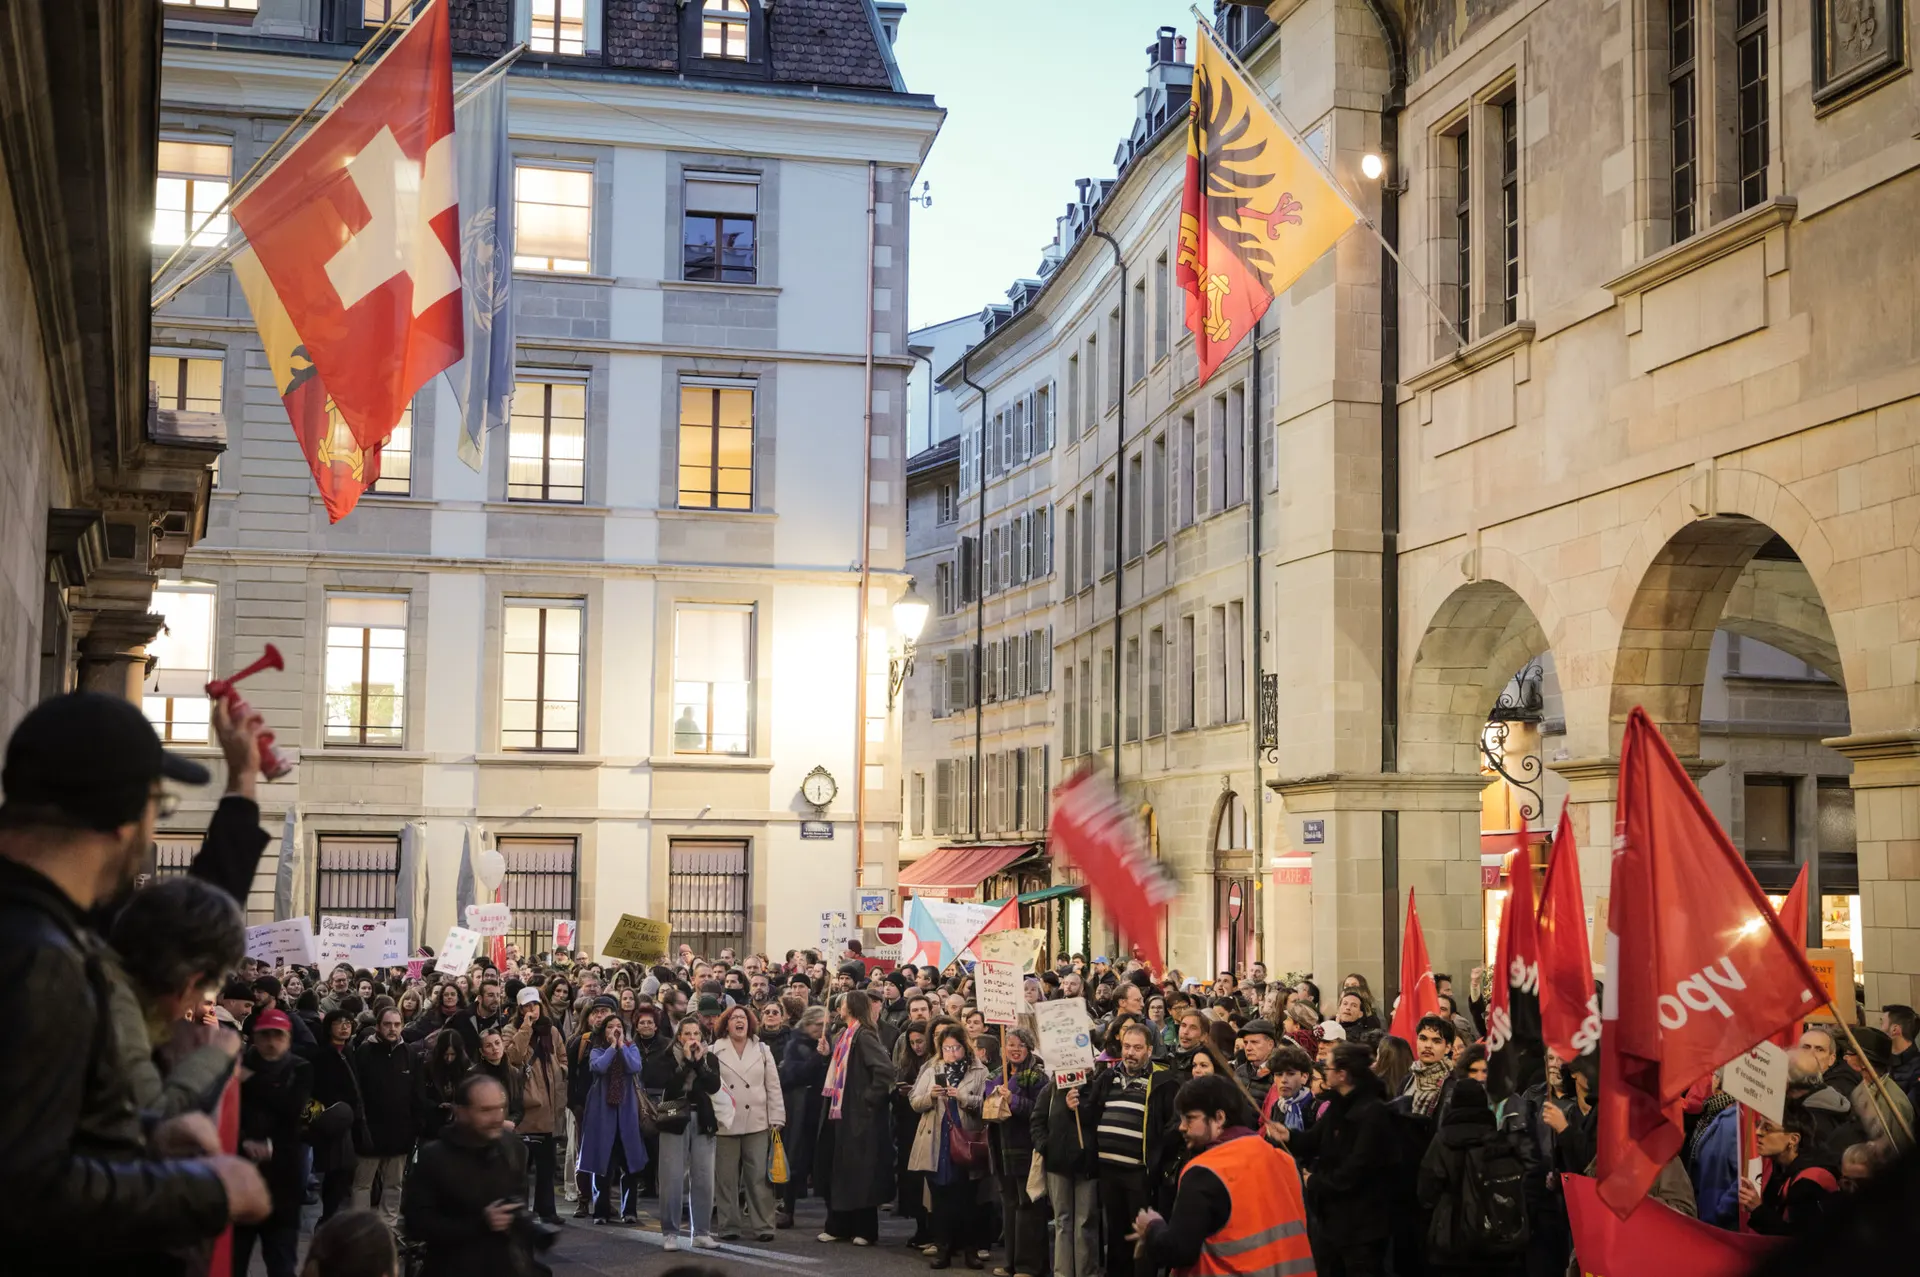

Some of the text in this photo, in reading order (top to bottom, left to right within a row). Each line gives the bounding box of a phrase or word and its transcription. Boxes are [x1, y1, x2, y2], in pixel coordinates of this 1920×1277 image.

[322, 917, 350, 931] Quand
[623, 918, 661, 934] TAXEZ LES
[631, 941, 643, 950] LES
[1744, 1056, 1767, 1077] Mesures
